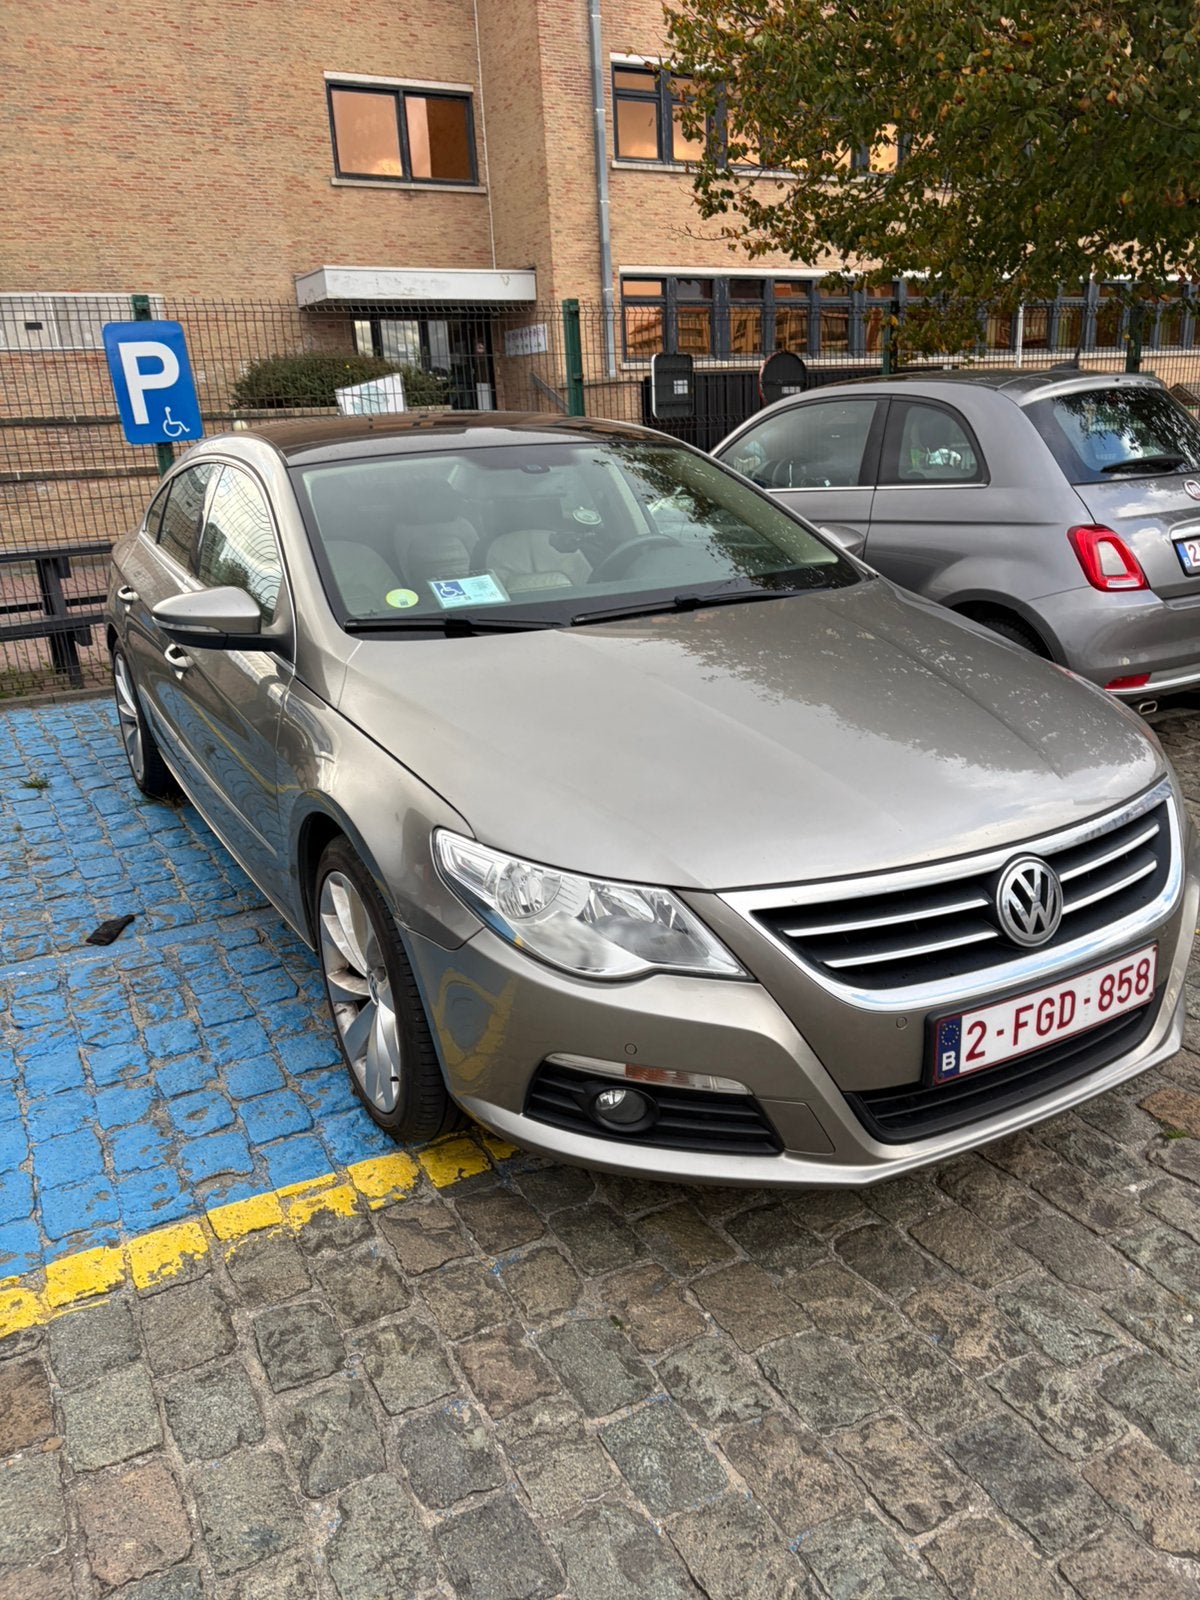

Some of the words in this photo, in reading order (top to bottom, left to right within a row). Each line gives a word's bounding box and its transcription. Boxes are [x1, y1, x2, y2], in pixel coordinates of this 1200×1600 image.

[118, 341, 180, 425] P
[965, 957, 1150, 1062] 2-FGD-858
[941, 1050, 956, 1072] B
